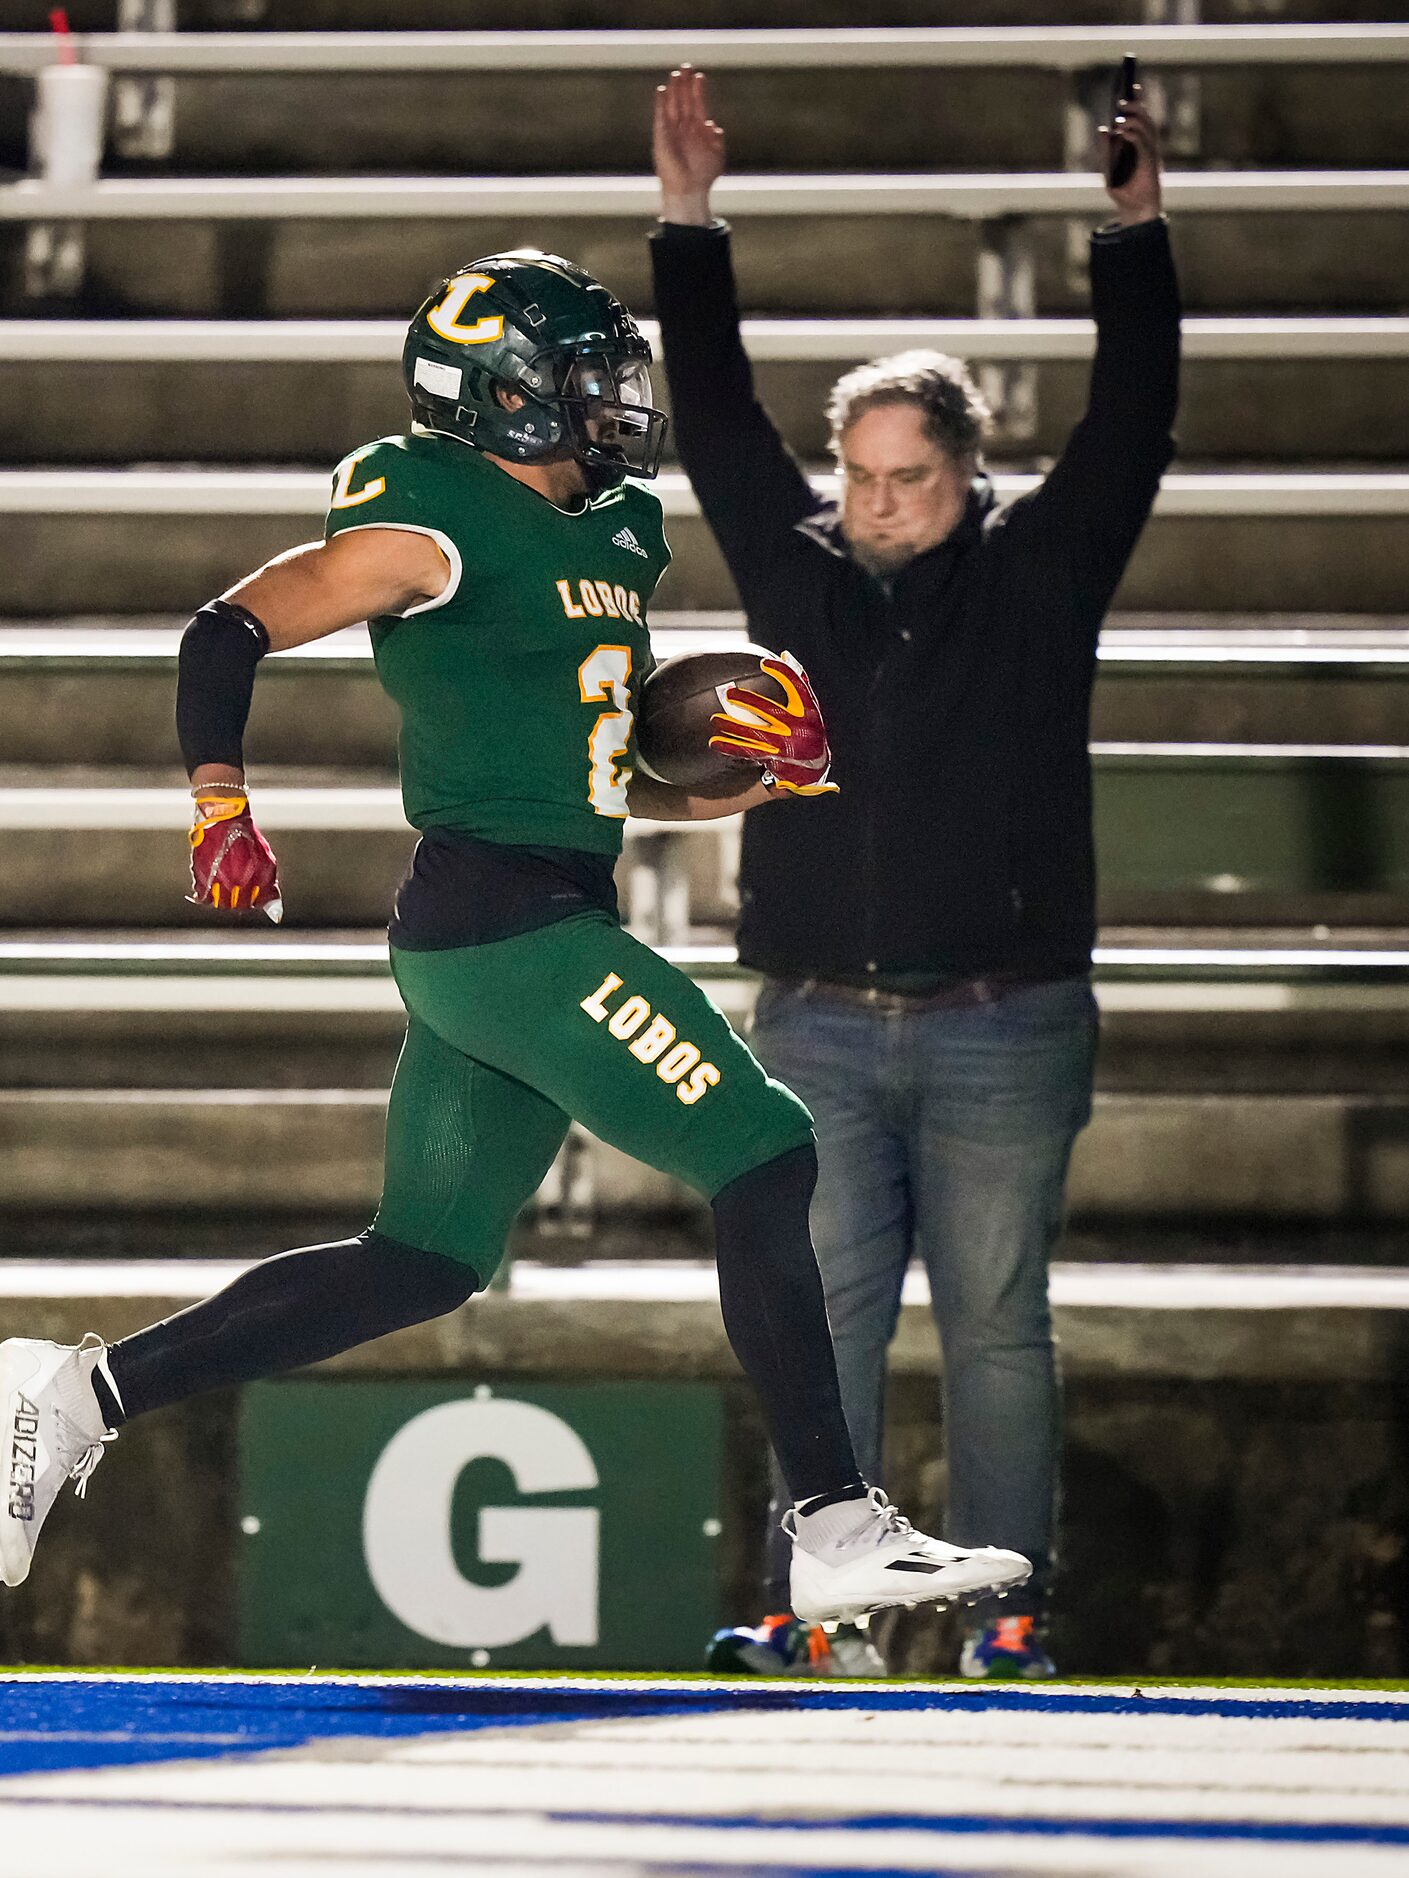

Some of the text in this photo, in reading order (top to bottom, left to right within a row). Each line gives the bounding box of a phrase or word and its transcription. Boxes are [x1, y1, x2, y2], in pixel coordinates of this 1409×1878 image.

[426, 273, 504, 345] L
[331, 452, 386, 509] L
[579, 971, 721, 1105] LOBOS
[8, 1390, 39, 1521] ADIZERO
[362, 1398, 599, 1648] G
